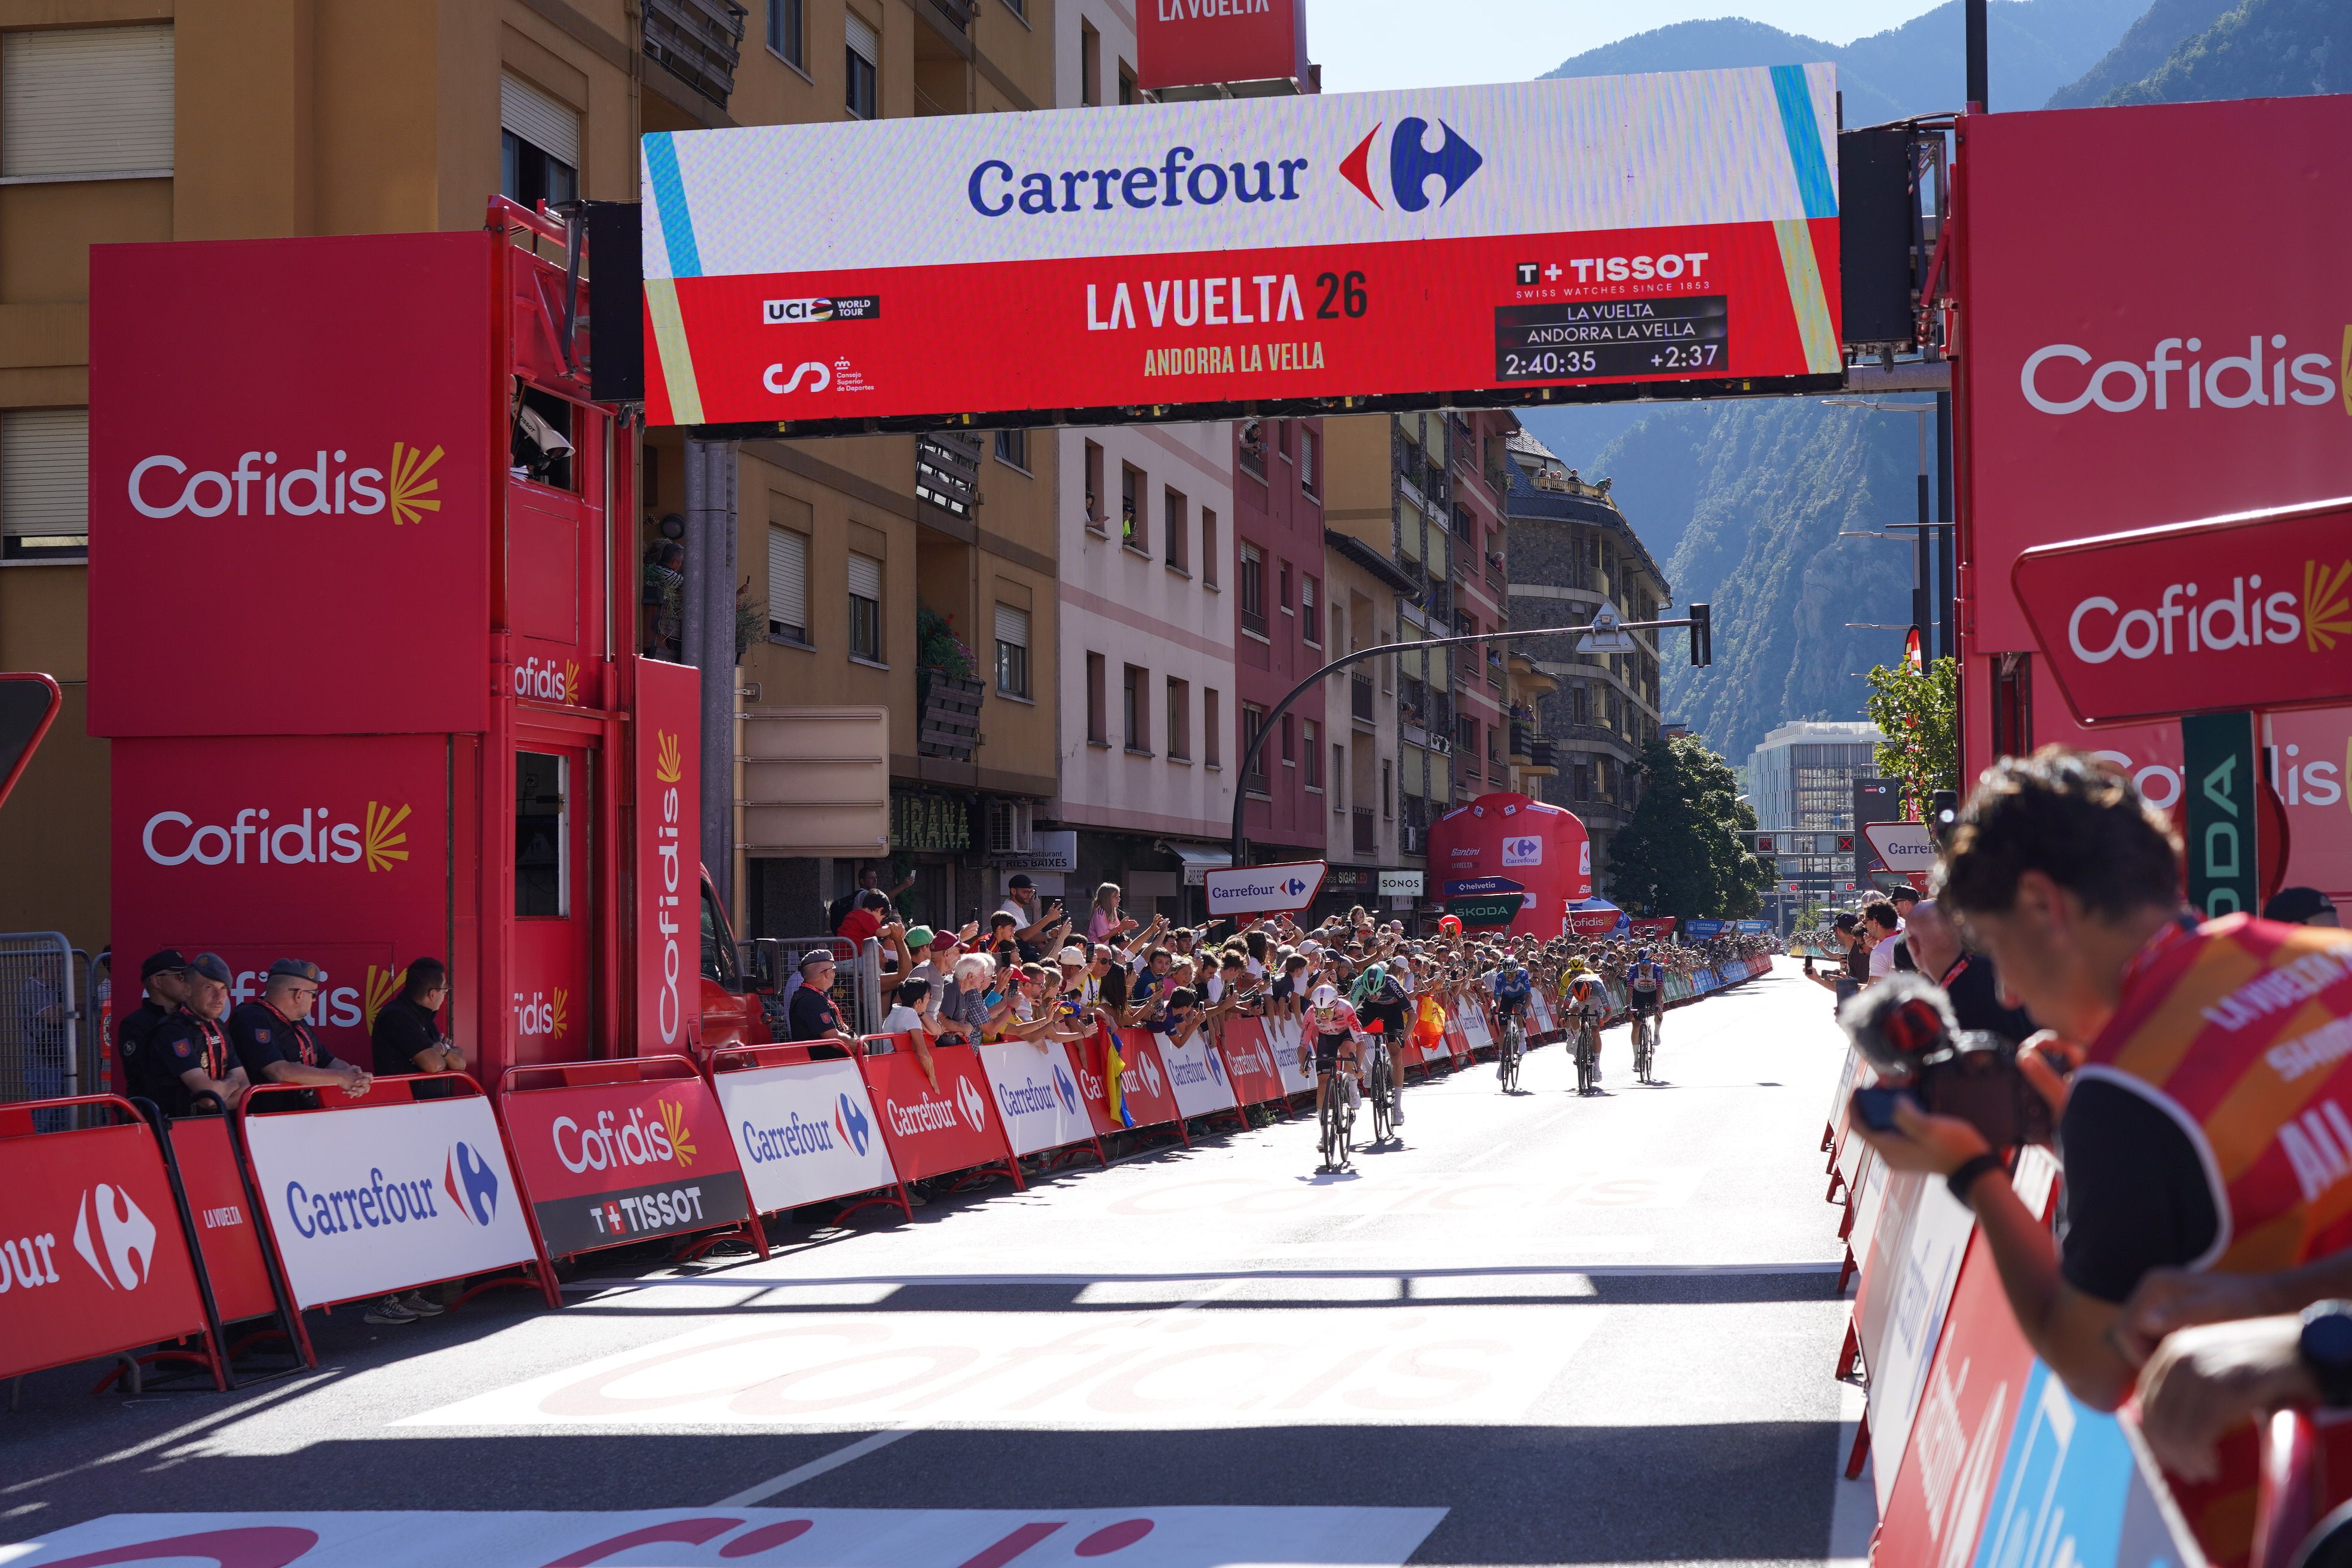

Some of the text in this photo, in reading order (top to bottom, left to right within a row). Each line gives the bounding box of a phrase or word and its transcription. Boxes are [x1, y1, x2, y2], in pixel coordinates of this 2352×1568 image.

[968, 146, 1308, 217] Carrefour
[1570, 252, 1708, 283] TISSOT
[837, 299, 871, 309] WORLD
[1087, 270, 1367, 331] LA VUELTA 26
[1516, 281, 1710, 299] SWISS WATCHES SINCE 1853
[769, 302, 807, 319] UCI
[839, 308, 863, 317] TOUR
[1567, 303, 1654, 321] LA VUELTA
[1527, 321, 1696, 344] ANDORRA LA VELLA
[1144, 341, 1325, 376] ANDORRA LA VELLA
[1505, 344, 1718, 375] 2:40:35 +2:37
[2020, 333, 2336, 415] Cofidis
[128, 449, 384, 519] Cofidis
[2068, 574, 2301, 664] Cofidis
[514, 656, 565, 702] ofidis
[142, 807, 363, 866] Cofidis
[1451, 847, 1481, 856] Santini
[1888, 843, 1935, 855] Carref
[1212, 884, 1275, 898] Carrefour
[1382, 879, 1419, 888] SONOS
[1466, 881, 1496, 890] helvetia
[658, 787, 679, 1045] Cofidis
[1566, 917, 1604, 927] Cofidis
[1387, 979, 1404, 999] Adecco
[1168, 1054, 1207, 1087] Carrefour
[1226, 1046, 1260, 1077] Carrefour
[999, 1076, 1056, 1117] Carrefour
[886, 1091, 957, 1138] Carrefour
[552, 1106, 674, 1175] Cofidis
[742, 1111, 835, 1164] Carrefour
[286, 1167, 438, 1240] Carrefour
[621, 1186, 705, 1232] TISSOT
